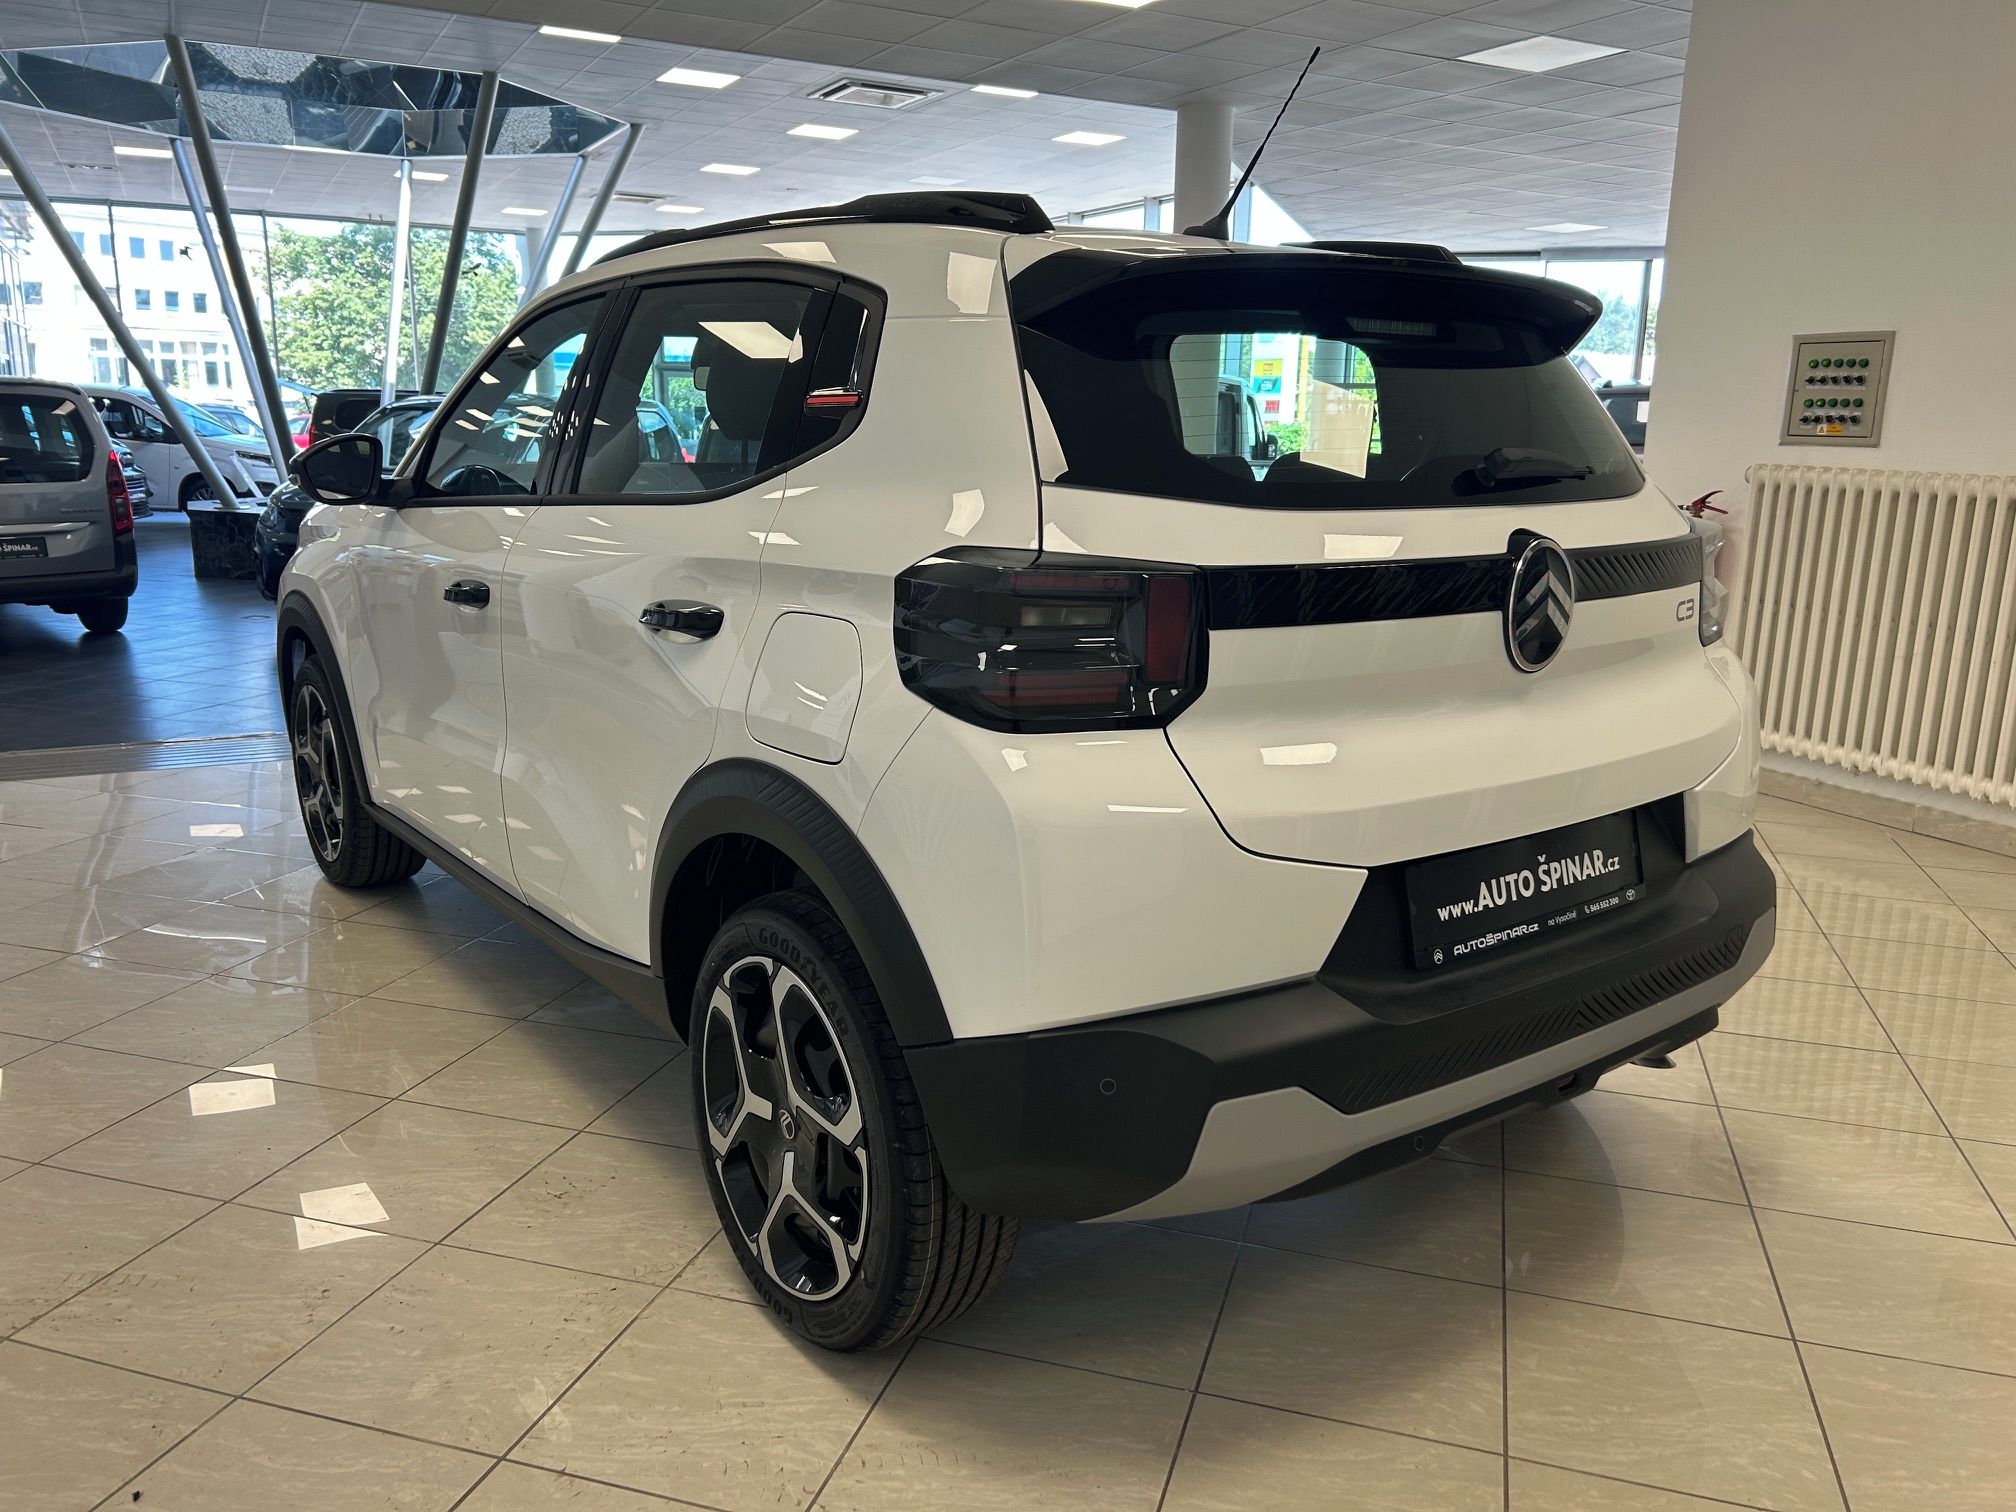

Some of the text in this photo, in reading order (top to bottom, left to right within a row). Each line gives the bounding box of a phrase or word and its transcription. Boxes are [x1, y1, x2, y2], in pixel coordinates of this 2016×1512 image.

[1676, 598, 1695, 622] C3
[1437, 849, 1620, 922] www.AUTO ŠPINAR.cz
[758, 927, 849, 1036] GOODYEAR
